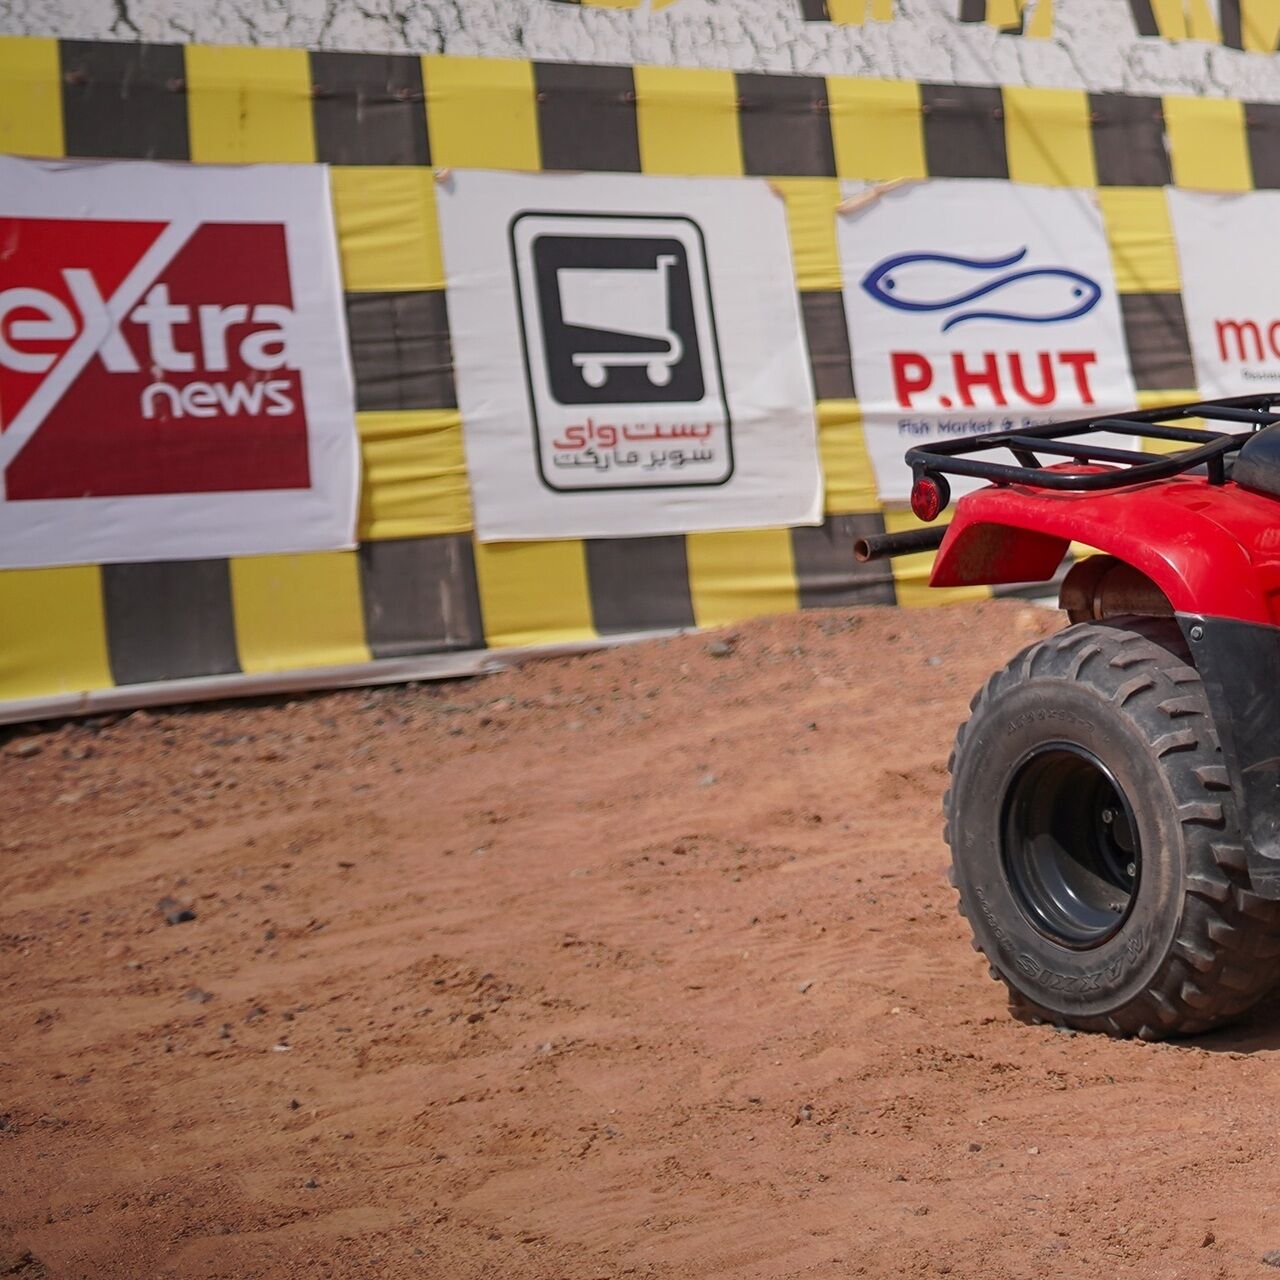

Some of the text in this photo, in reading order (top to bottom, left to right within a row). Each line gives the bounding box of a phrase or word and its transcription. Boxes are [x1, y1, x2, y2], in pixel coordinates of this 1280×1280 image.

[140, 379, 295, 419] news
[889, 350, 1098, 409] P.HUT
[1016, 929, 1145, 993] MAXXIS
